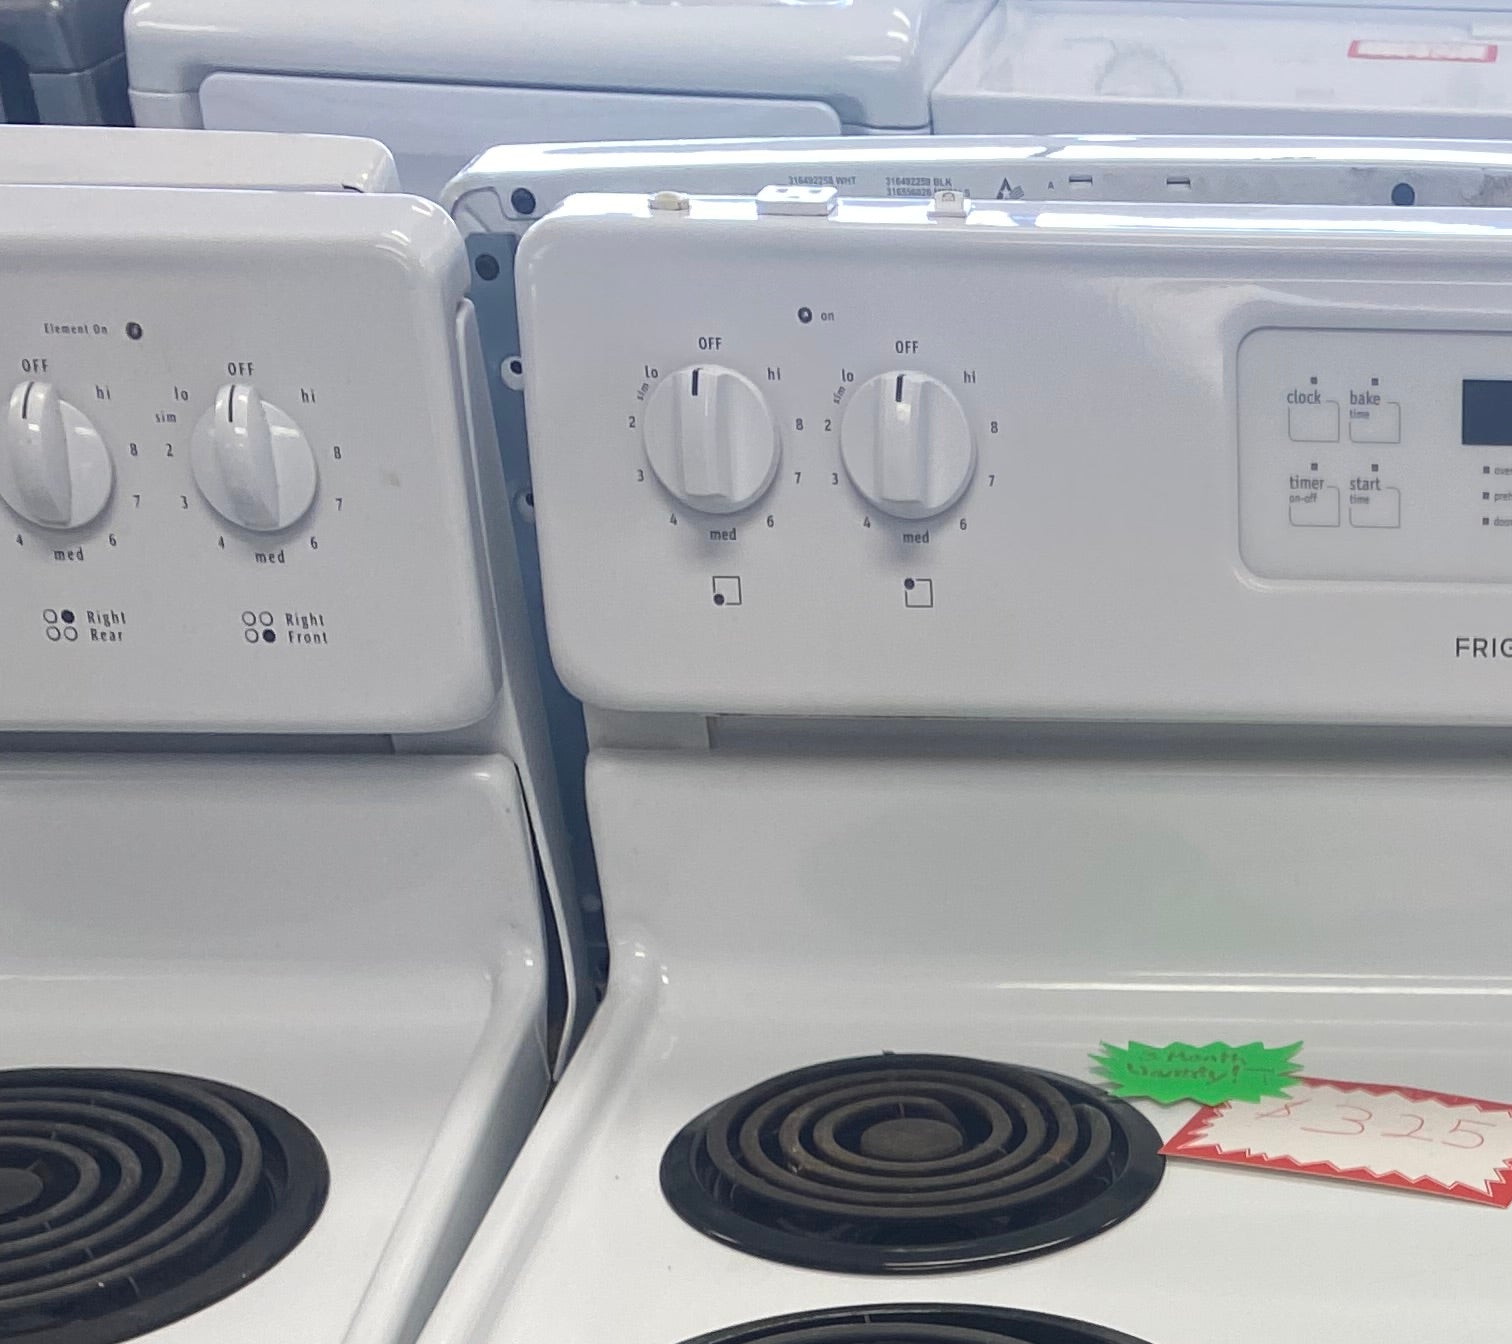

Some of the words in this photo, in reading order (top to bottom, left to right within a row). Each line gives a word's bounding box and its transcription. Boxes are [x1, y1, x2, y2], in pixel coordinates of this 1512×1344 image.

[820, 311, 835, 322] on
[43, 322, 89, 335] Element
[92, 323, 108, 335] On
[698, 336, 722, 350] OFF
[895, 340, 919, 354] OFF
[21, 358, 49, 373] OFF
[227, 362, 254, 377] OFF
[644, 364, 659, 379] lo
[767, 366, 781, 381] hi
[841, 368, 854, 383] lo
[963, 370, 976, 384] hi
[95, 384, 111, 400] hi
[174, 385, 189, 402] lo
[300, 387, 316, 403] hi
[1286, 388, 1322, 405] clock
[1349, 389, 1382, 406] bake
[155, 412, 177, 423] sim
[1349, 408, 1371, 420] time
[628, 415, 636, 429] 2
[795, 417, 804, 431] 8
[824, 418, 832, 432] 2
[990, 420, 999, 434] 8
[129, 442, 139, 457] 8
[165, 443, 174, 457] 2
[333, 445, 342, 460] 8
[637, 468, 645, 482] 3
[794, 471, 802, 485] 7
[831, 472, 839, 486] 3
[988, 474, 995, 487] 7
[1289, 474, 1325, 491] timer
[1349, 476, 1382, 491] start
[132, 494, 141, 508] 7
[180, 495, 189, 510] 3
[335, 497, 343, 512] 7
[1349, 493, 1371, 505] time
[669, 512, 678, 526] 4
[766, 514, 775, 528] 6
[863, 515, 871, 529] 4
[959, 517, 968, 531] 6
[16, 534, 24, 546] 4
[108, 533, 117, 547] 6
[709, 527, 737, 541] med
[902, 529, 930, 544] med
[218, 535, 225, 549] 4
[310, 536, 318, 550] 6
[52, 546, 84, 561] med
[254, 549, 286, 564] med
[86, 609, 126, 628] Right
[285, 612, 325, 630] Right
[89, 627, 123, 642] Rear
[288, 630, 328, 645] Front
